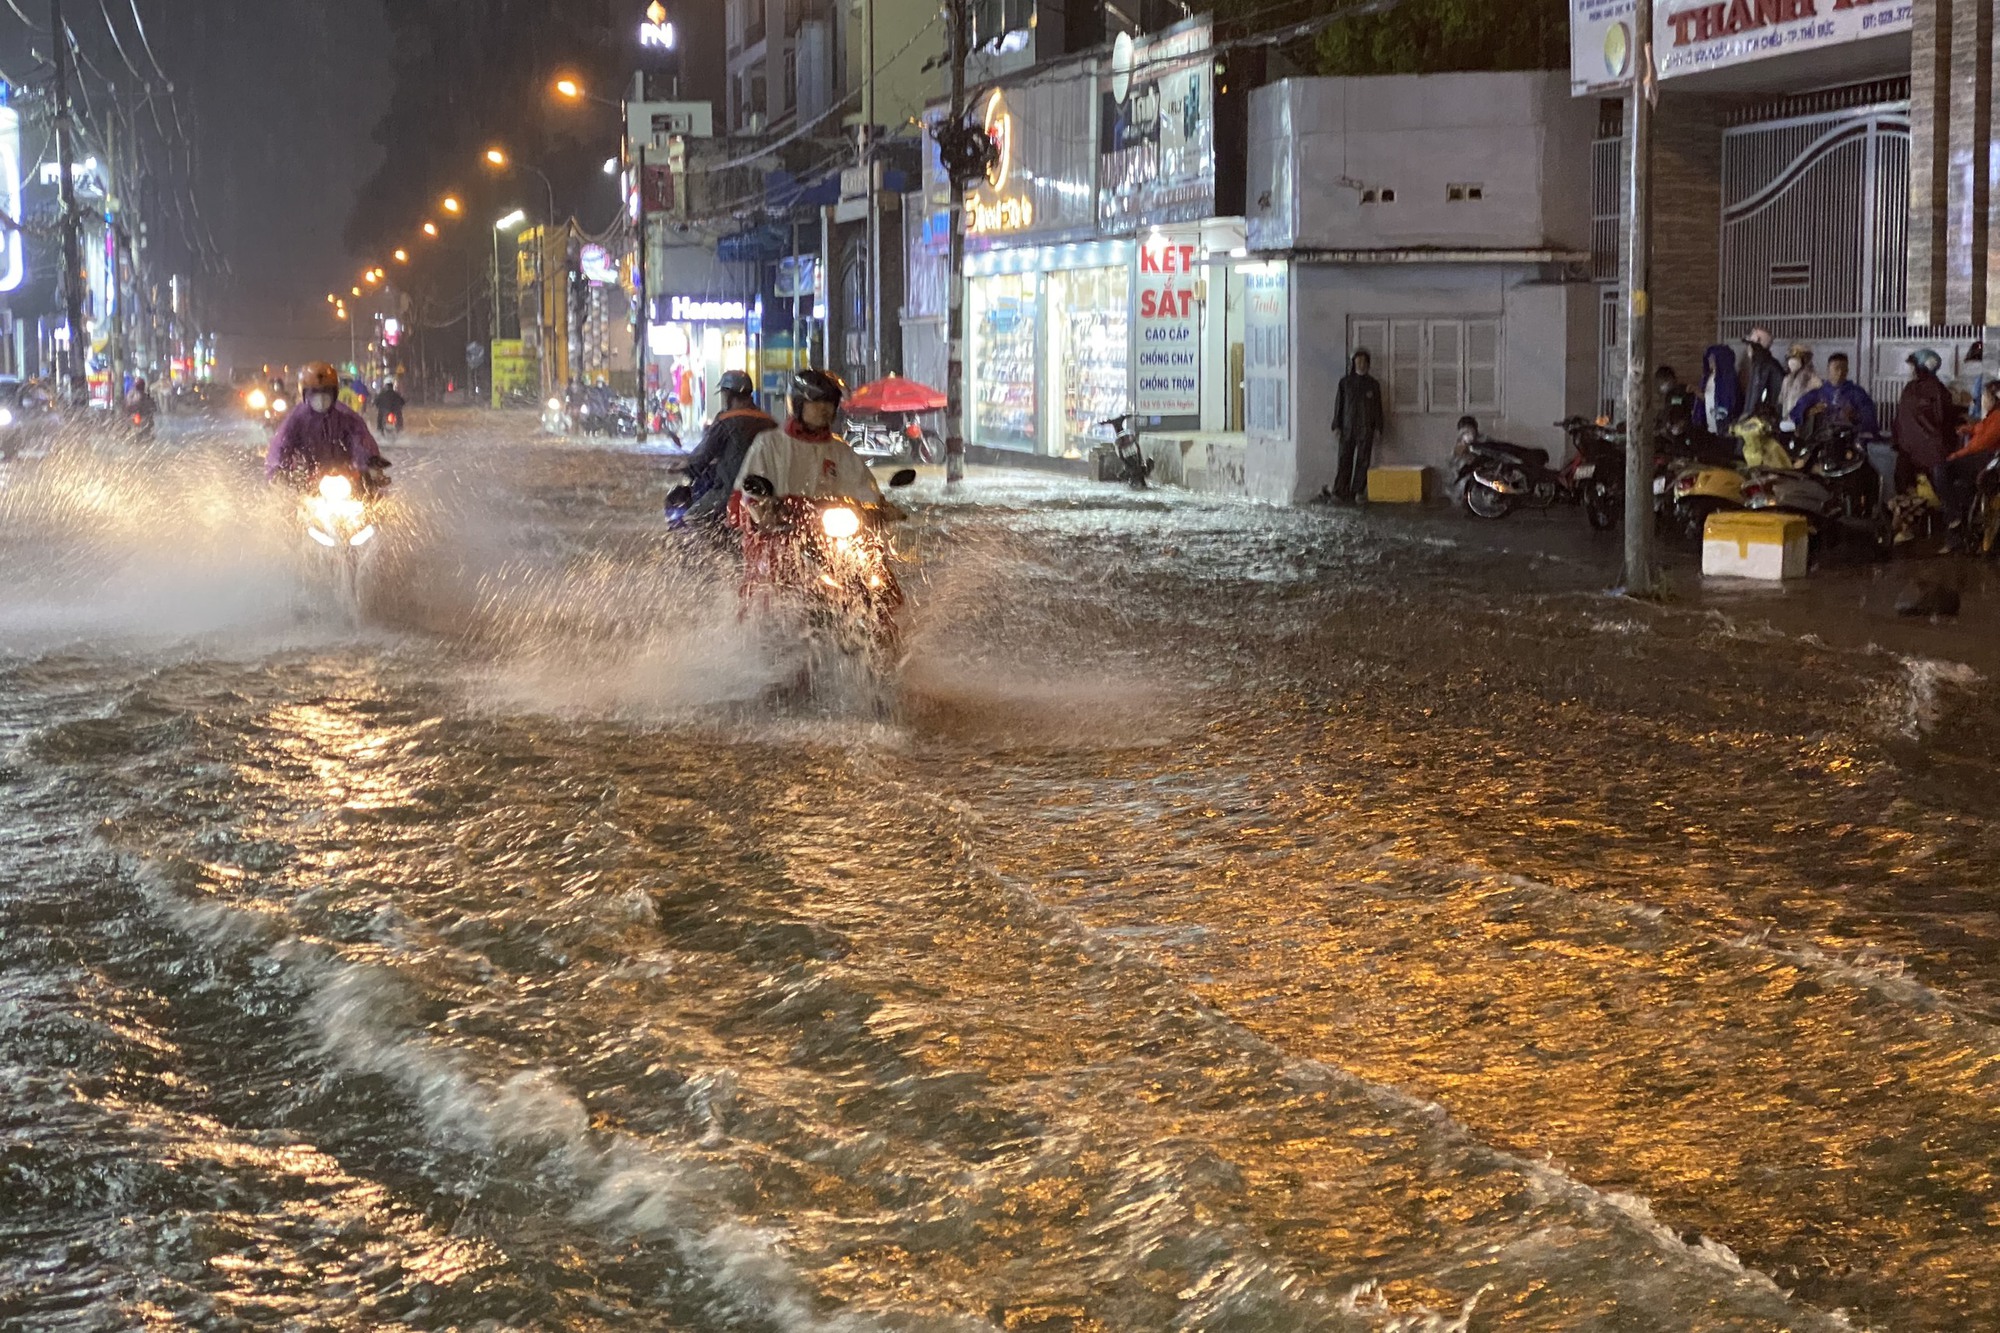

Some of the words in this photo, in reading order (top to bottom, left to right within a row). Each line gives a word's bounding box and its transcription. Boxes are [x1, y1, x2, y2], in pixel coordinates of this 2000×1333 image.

[641, 22, 673, 48] PNJ
[1141, 275, 1193, 318] SẮT
[1145, 327, 1166, 341] CAO
[1169, 322, 1189, 341] CẤP
[1140, 347, 1169, 366] CHỐNG
[1171, 350, 1194, 366] CHÁY
[1140, 371, 1169, 391] CHỐNG
[1172, 374, 1195, 394] TRỘM
